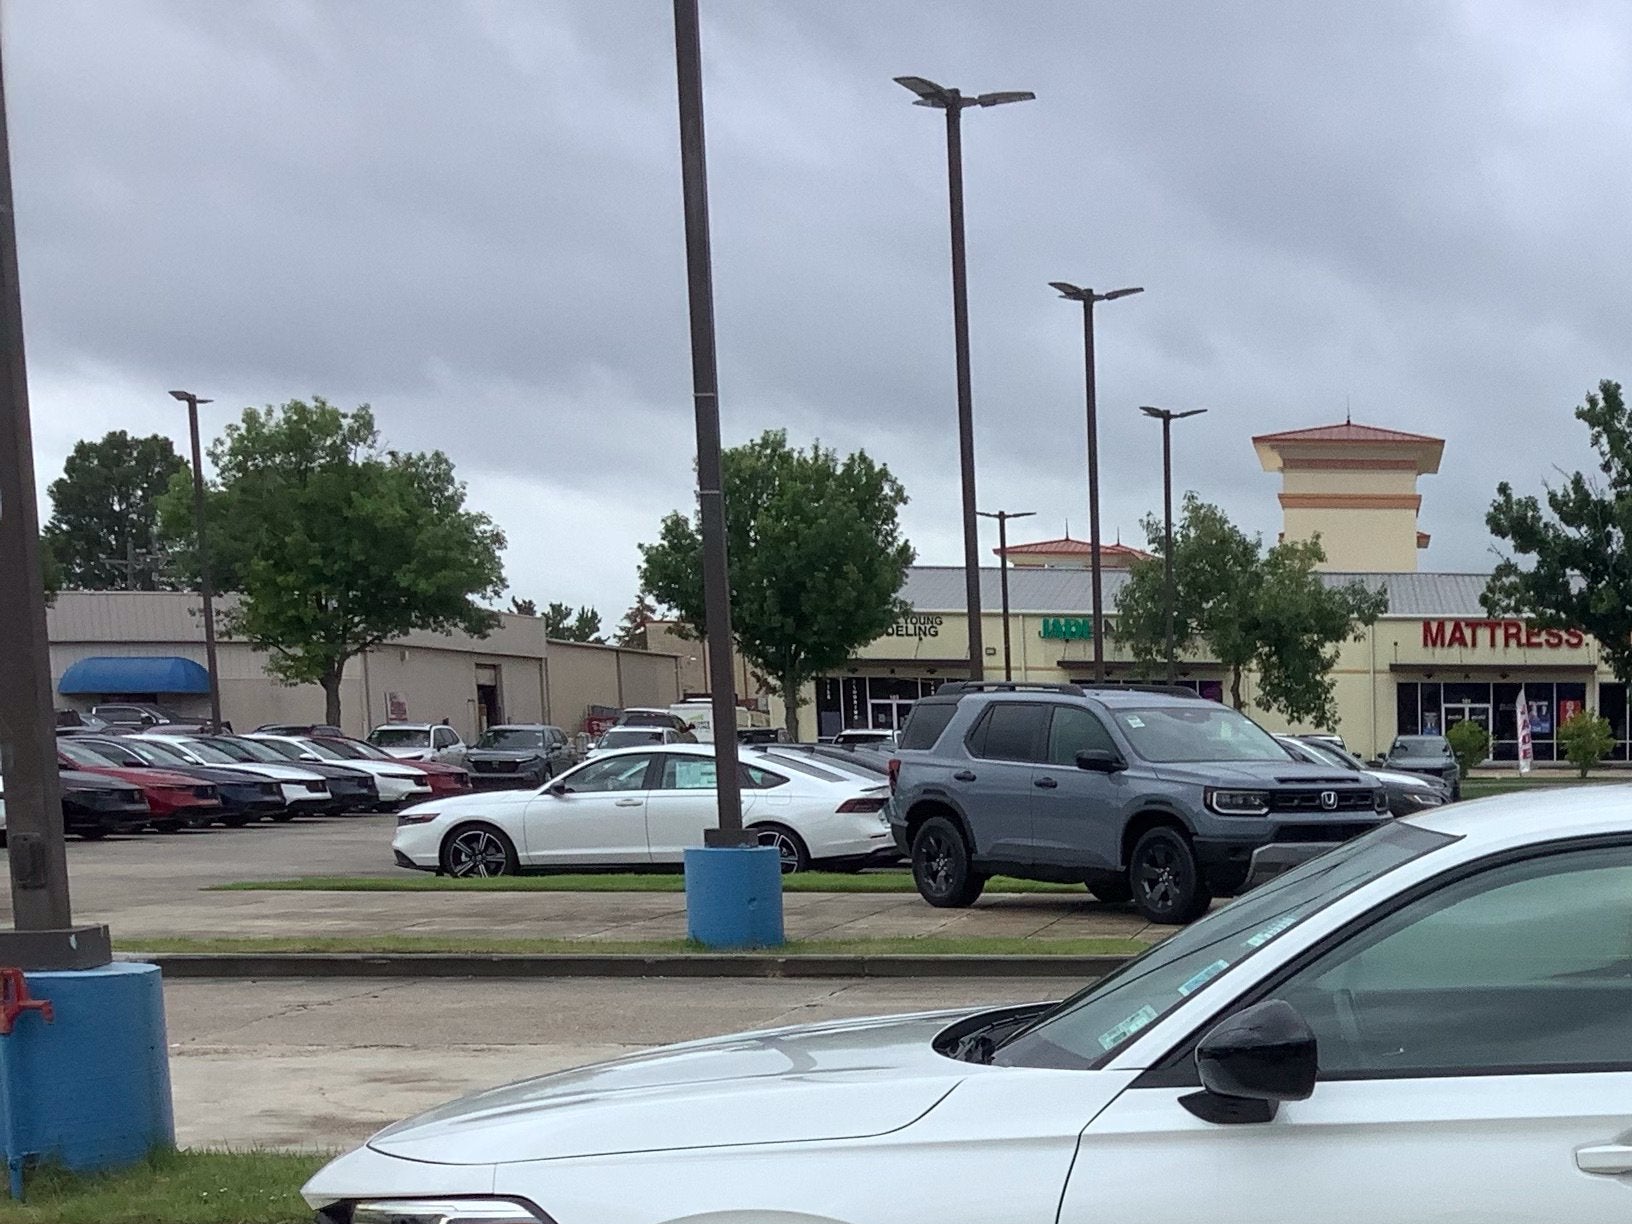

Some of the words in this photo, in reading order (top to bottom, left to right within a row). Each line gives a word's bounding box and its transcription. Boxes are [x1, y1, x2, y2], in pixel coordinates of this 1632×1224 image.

[902, 616, 943, 626] YOUNG
[885, 626, 938, 637] DELING
[1422, 620, 1584, 648] MATTRESS
